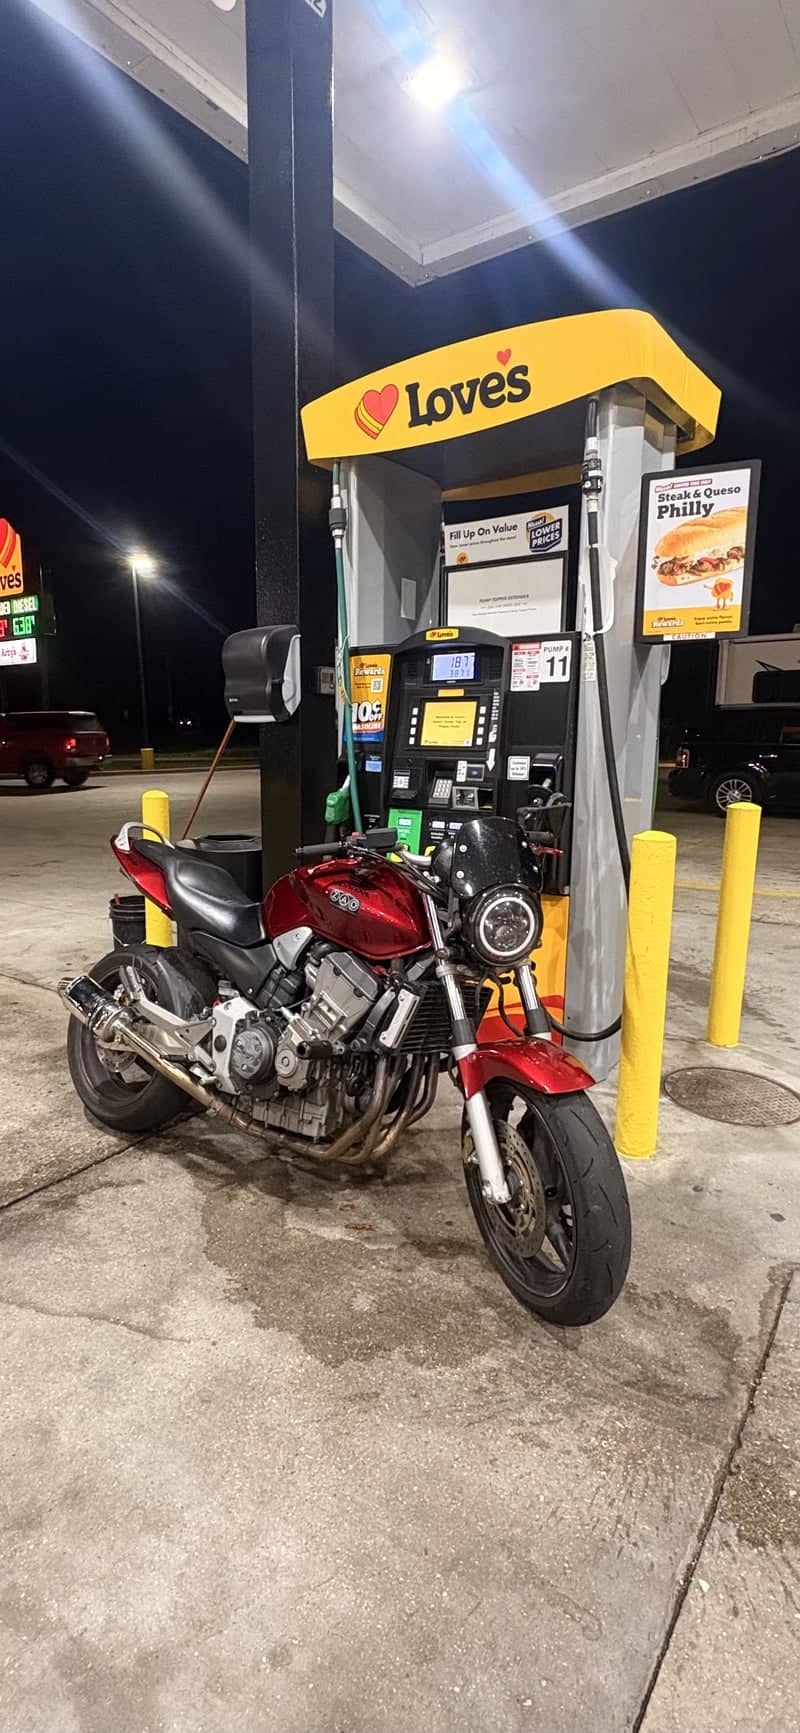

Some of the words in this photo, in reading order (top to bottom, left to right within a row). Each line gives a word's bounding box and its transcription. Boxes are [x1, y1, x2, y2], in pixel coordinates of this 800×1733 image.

[657, 489, 691, 503] Steak
[693, 488, 702, 498] &
[703, 486, 741, 499] Queso
[656, 501, 715, 519] Philly
[449, 530, 461, 541] Fill
[463, 528, 476, 540] Up
[477, 526, 491, 537] On
[492, 522, 518, 534] Value
[531, 521, 560, 539] LOWER
[531, 530, 561, 547] PRICES
[13, 596, 37, 614] DIESEL
[543, 645, 564, 653] PUMP
[546, 656, 568, 677] 11
[368, 713, 383, 721] OFF
